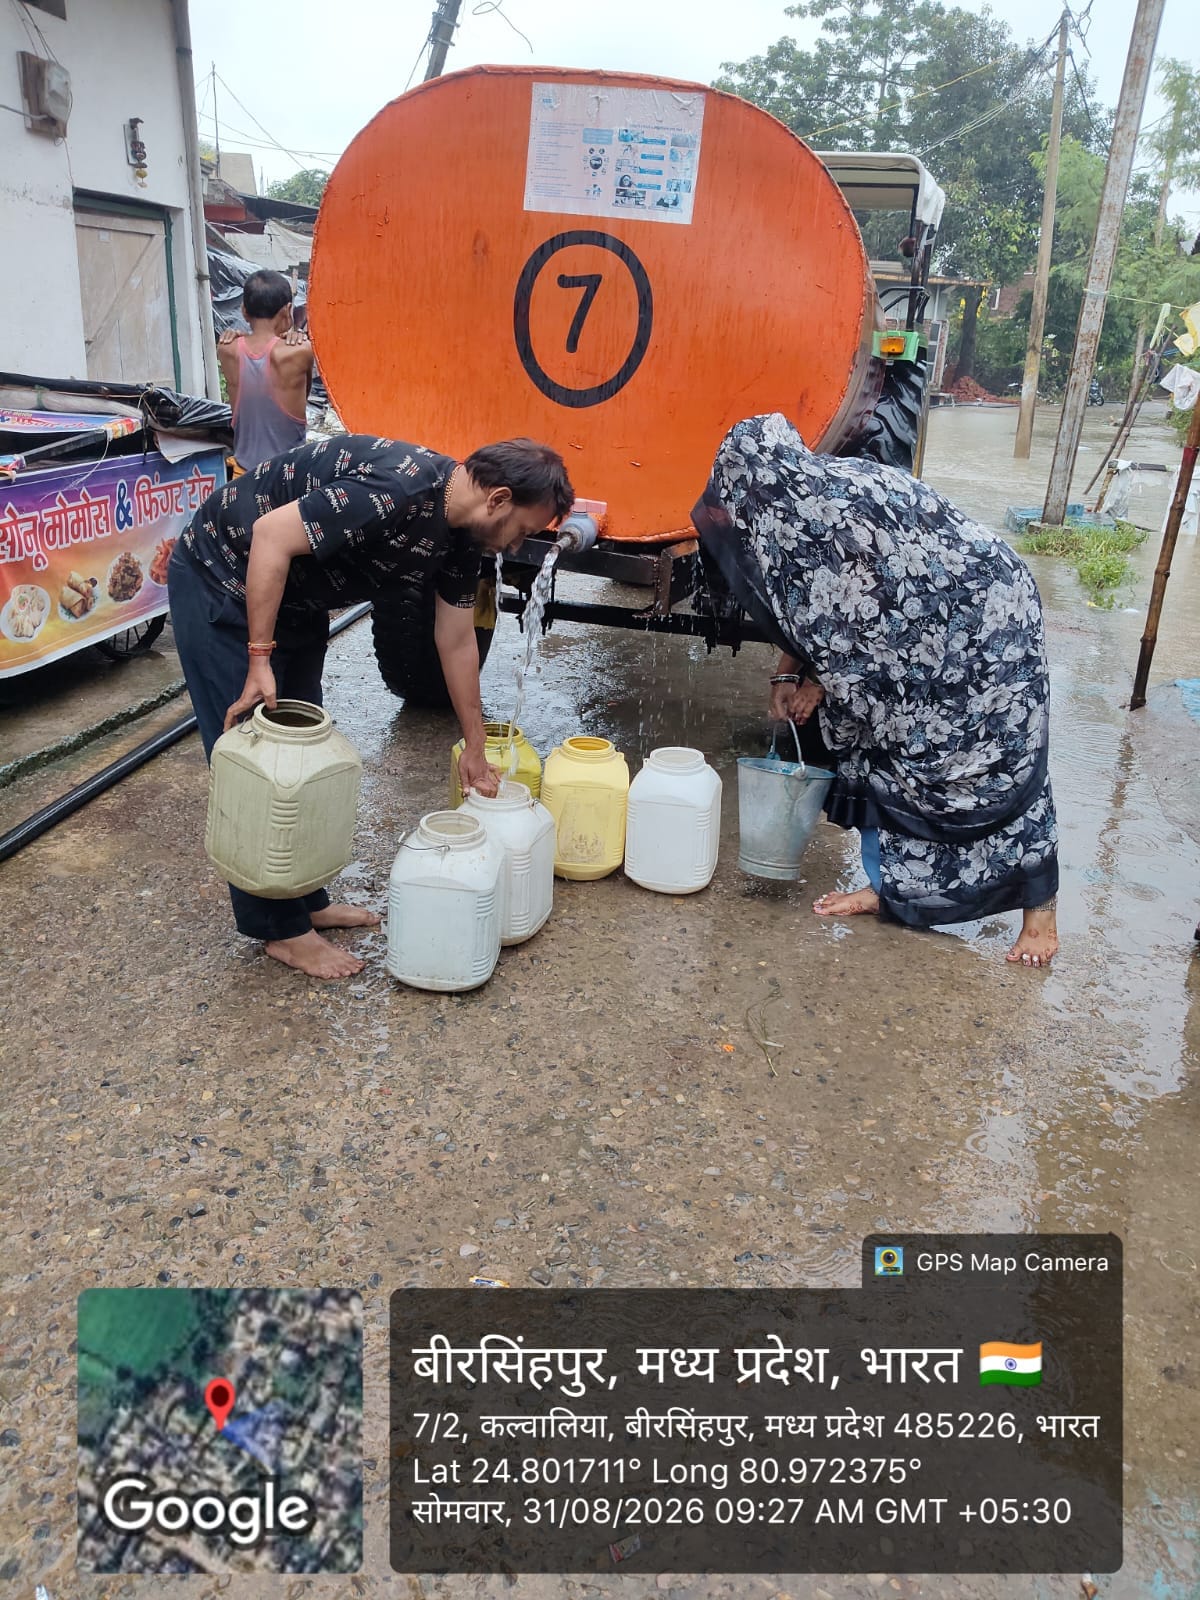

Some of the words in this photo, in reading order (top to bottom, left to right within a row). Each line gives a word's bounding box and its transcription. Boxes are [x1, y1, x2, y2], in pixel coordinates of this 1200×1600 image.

[557, 273, 603, 354] 7
[43, 487, 111, 549] मोमोस
[115, 480, 133, 532] &
[134, 472, 185, 526] फिंगर
